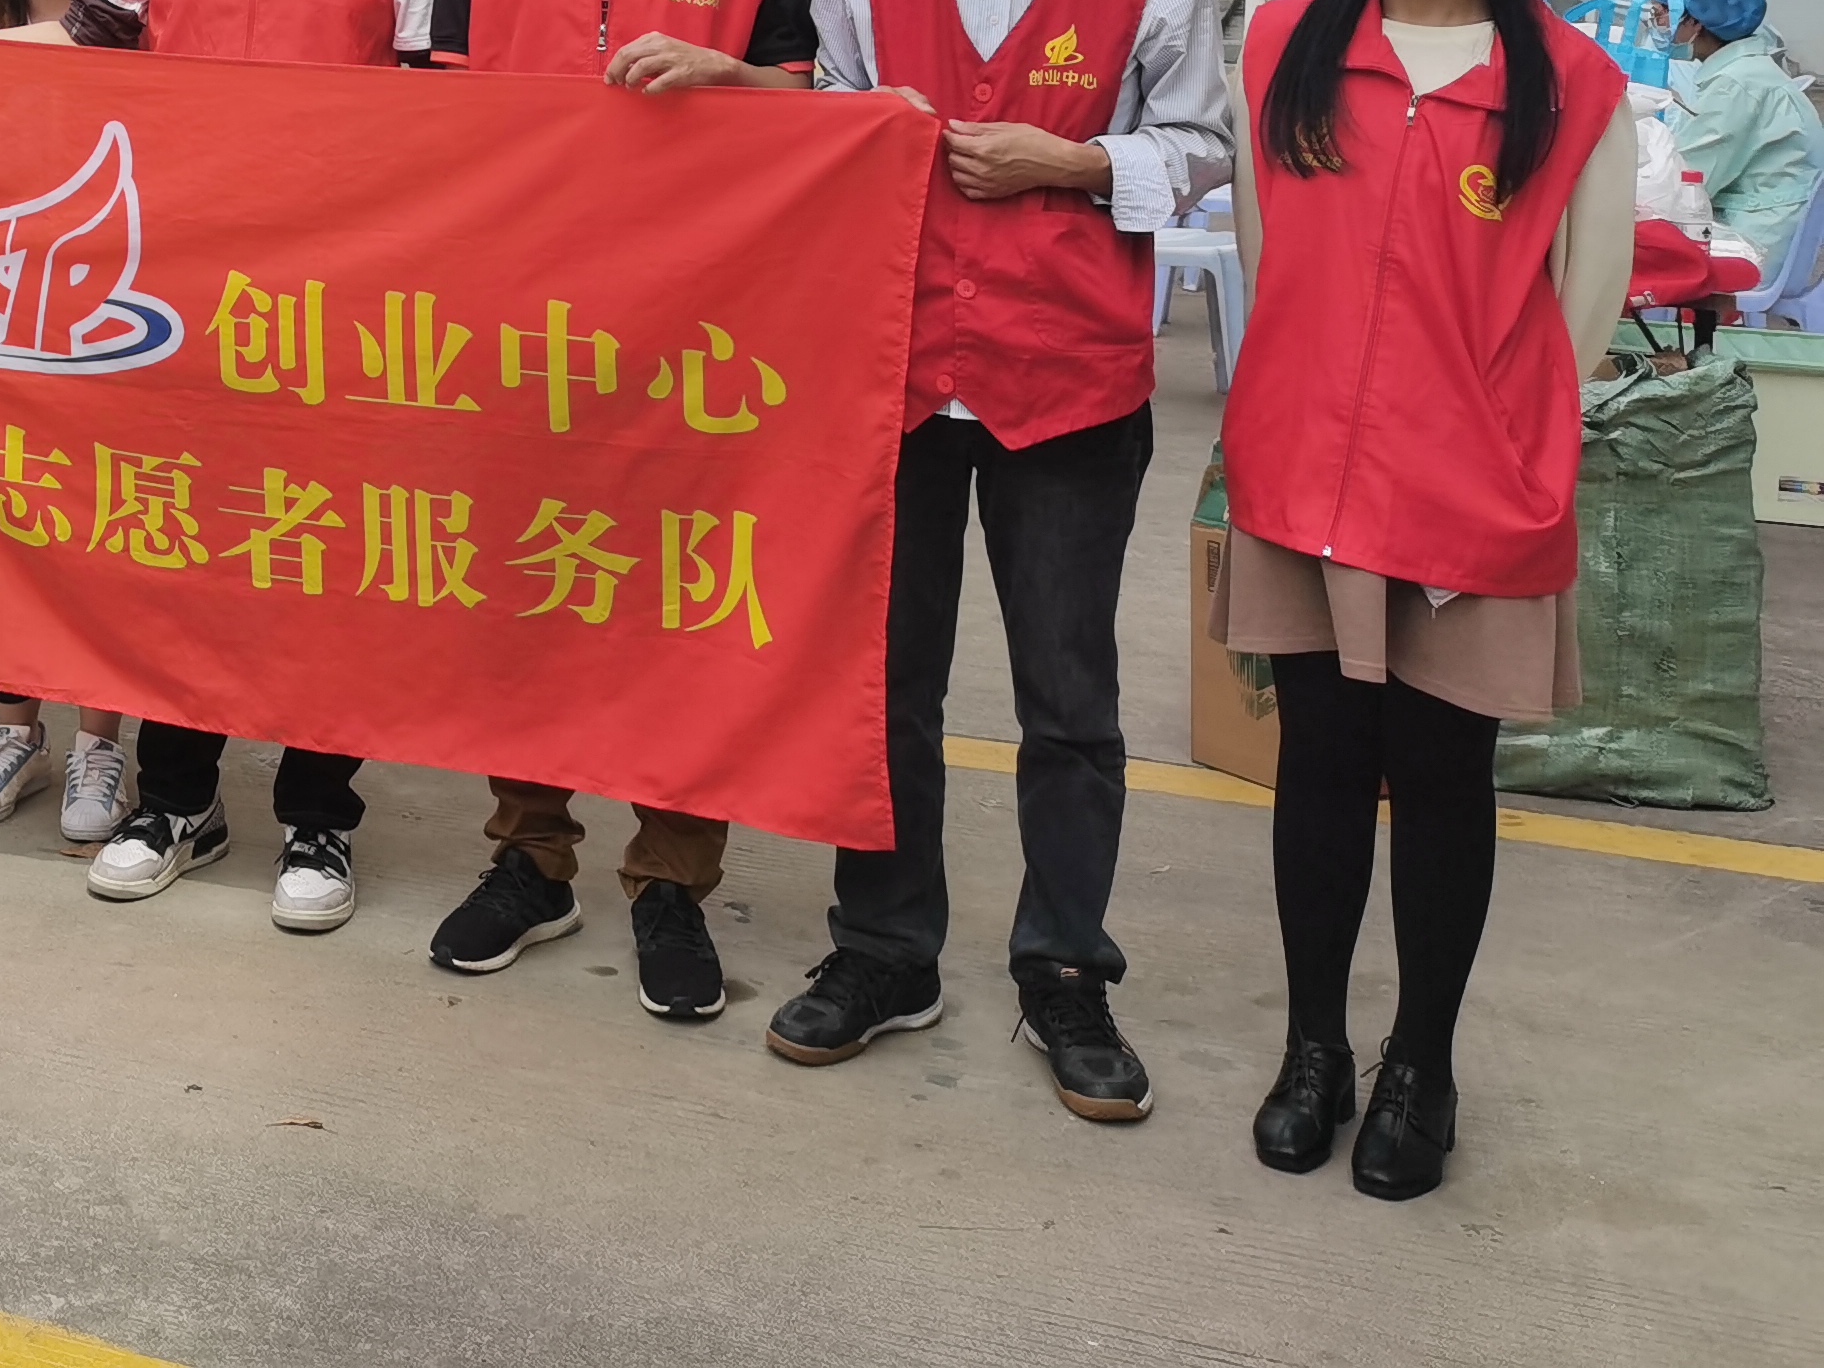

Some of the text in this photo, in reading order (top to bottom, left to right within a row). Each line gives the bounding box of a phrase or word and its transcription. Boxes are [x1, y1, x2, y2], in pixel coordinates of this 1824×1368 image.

[1028, 68, 1097, 90] 创业中心
[205, 269, 788, 435] 创业中心
